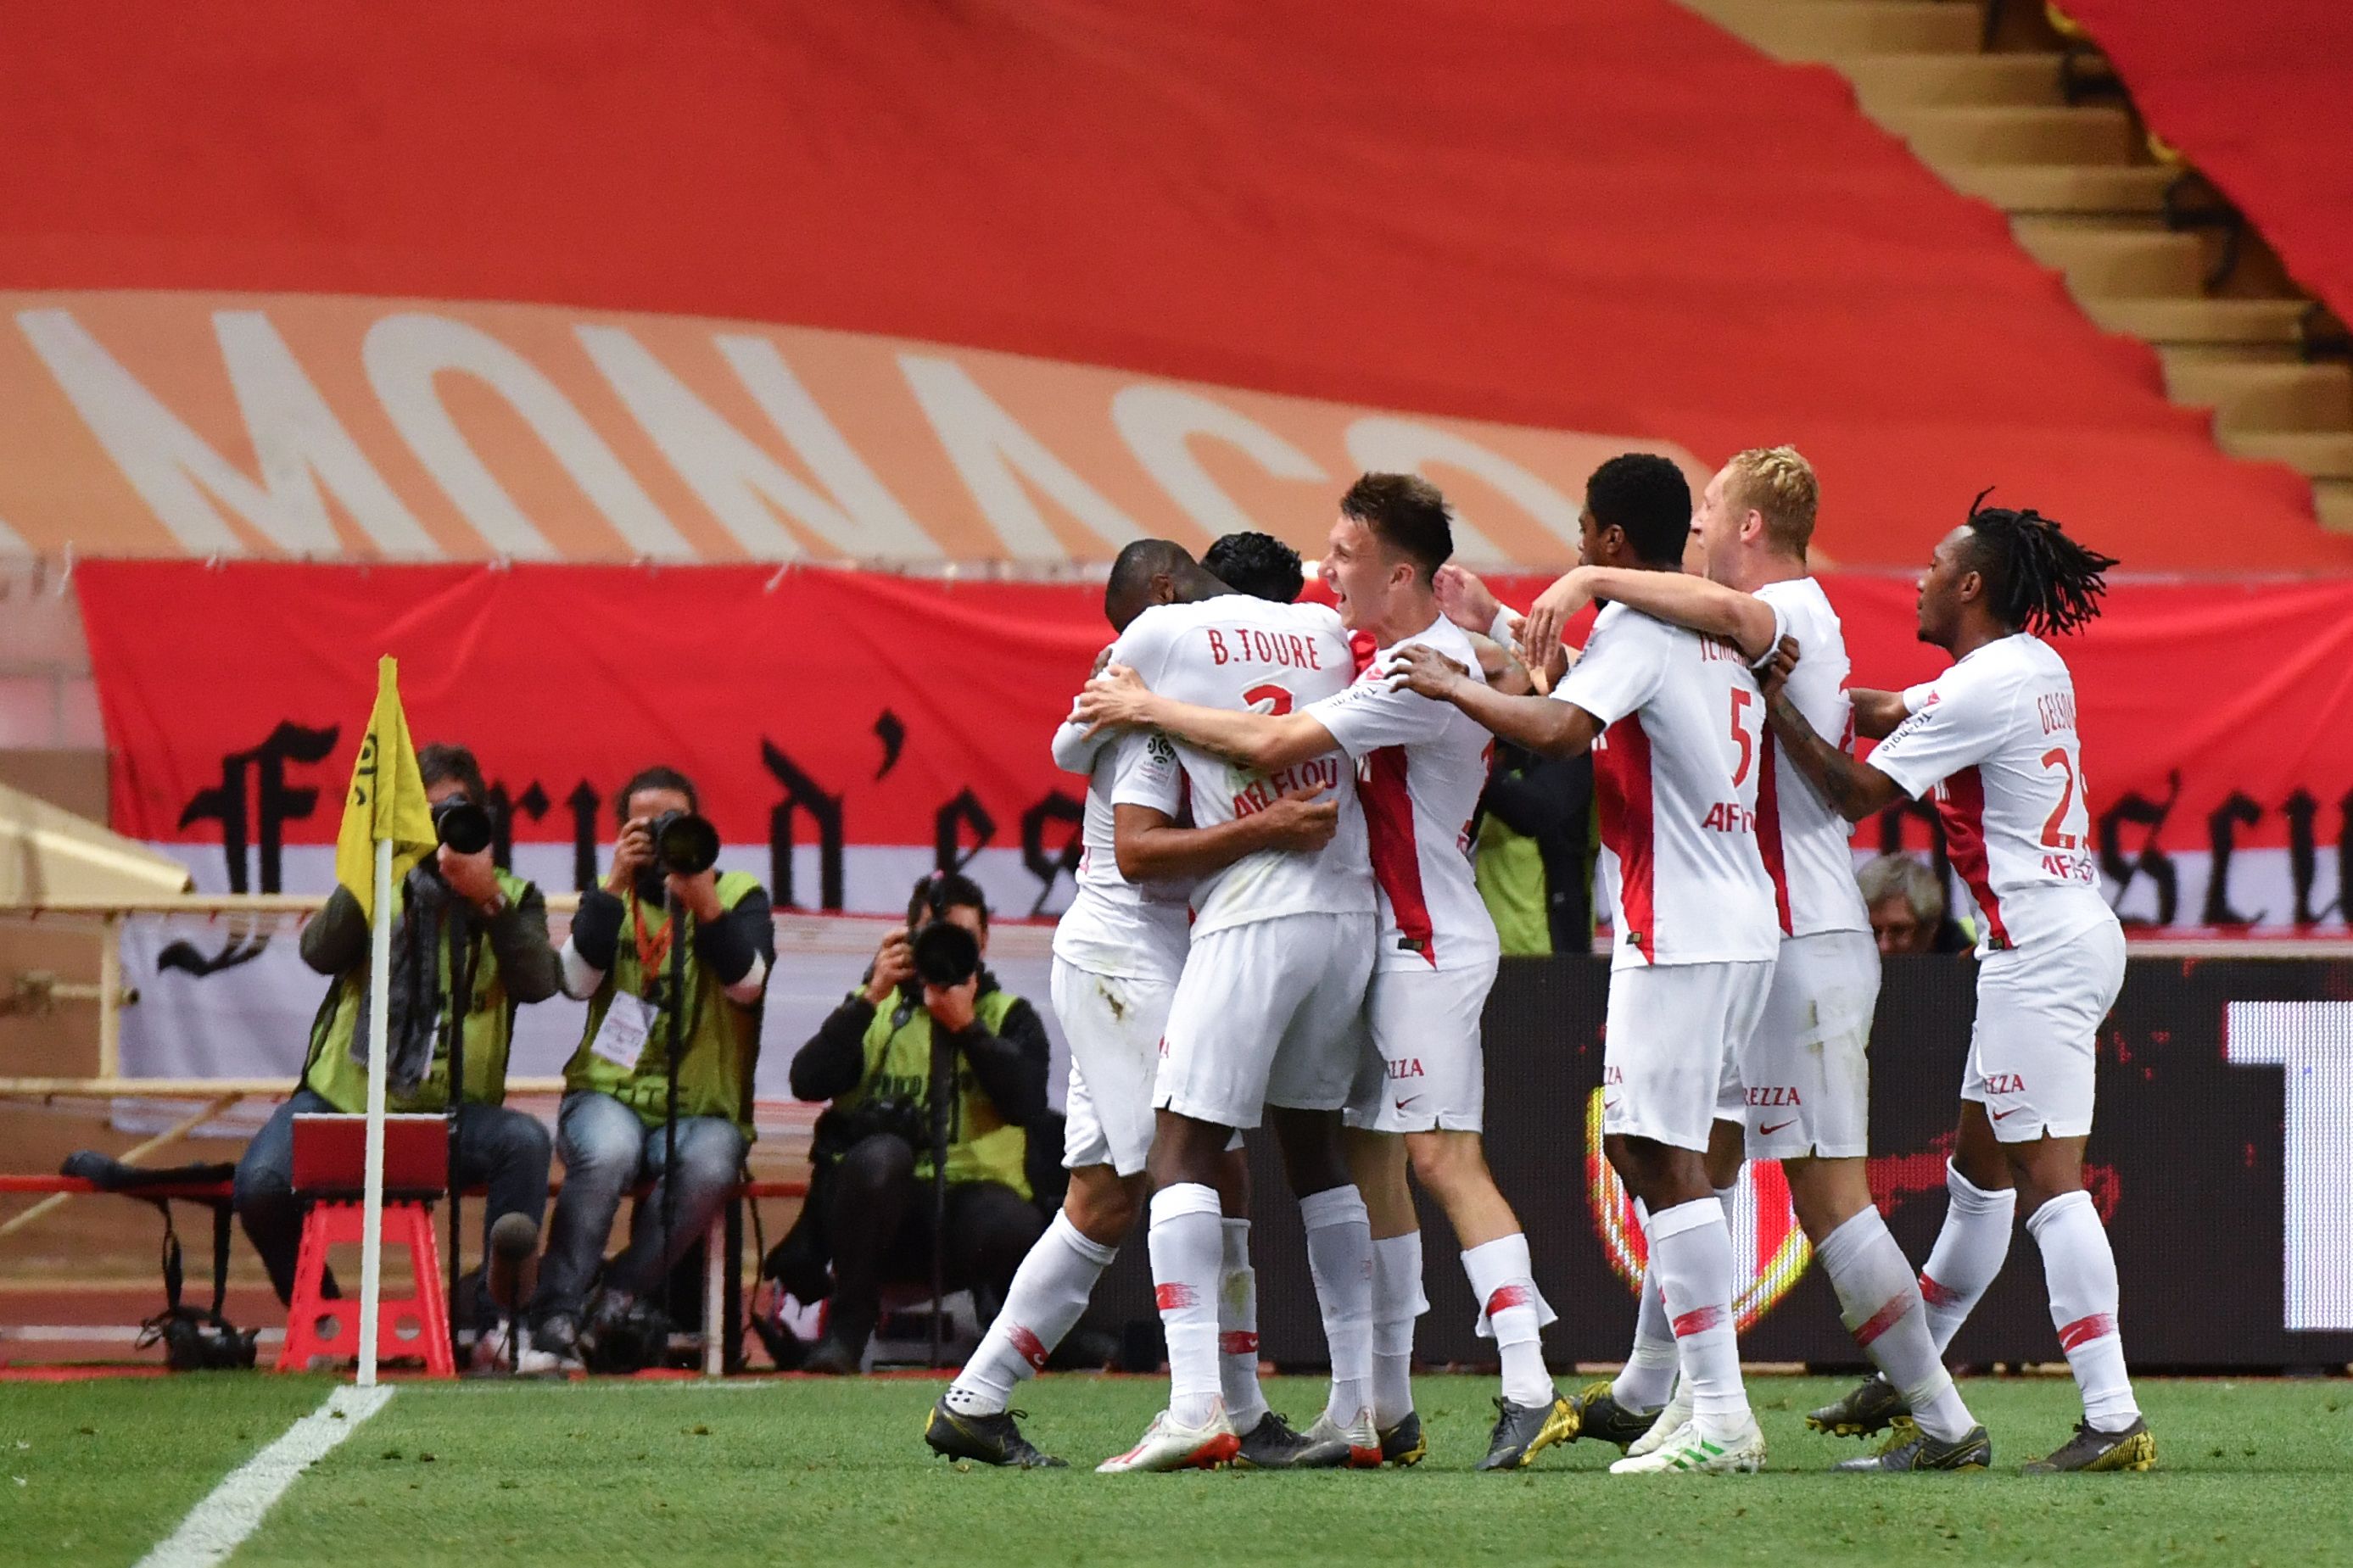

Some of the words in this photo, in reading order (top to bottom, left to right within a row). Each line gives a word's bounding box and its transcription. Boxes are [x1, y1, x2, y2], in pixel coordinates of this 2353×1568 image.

[1208, 628, 1322, 671] B.TOURE
[1730, 686, 1752, 788] 5
[2041, 746, 2088, 851] 2
